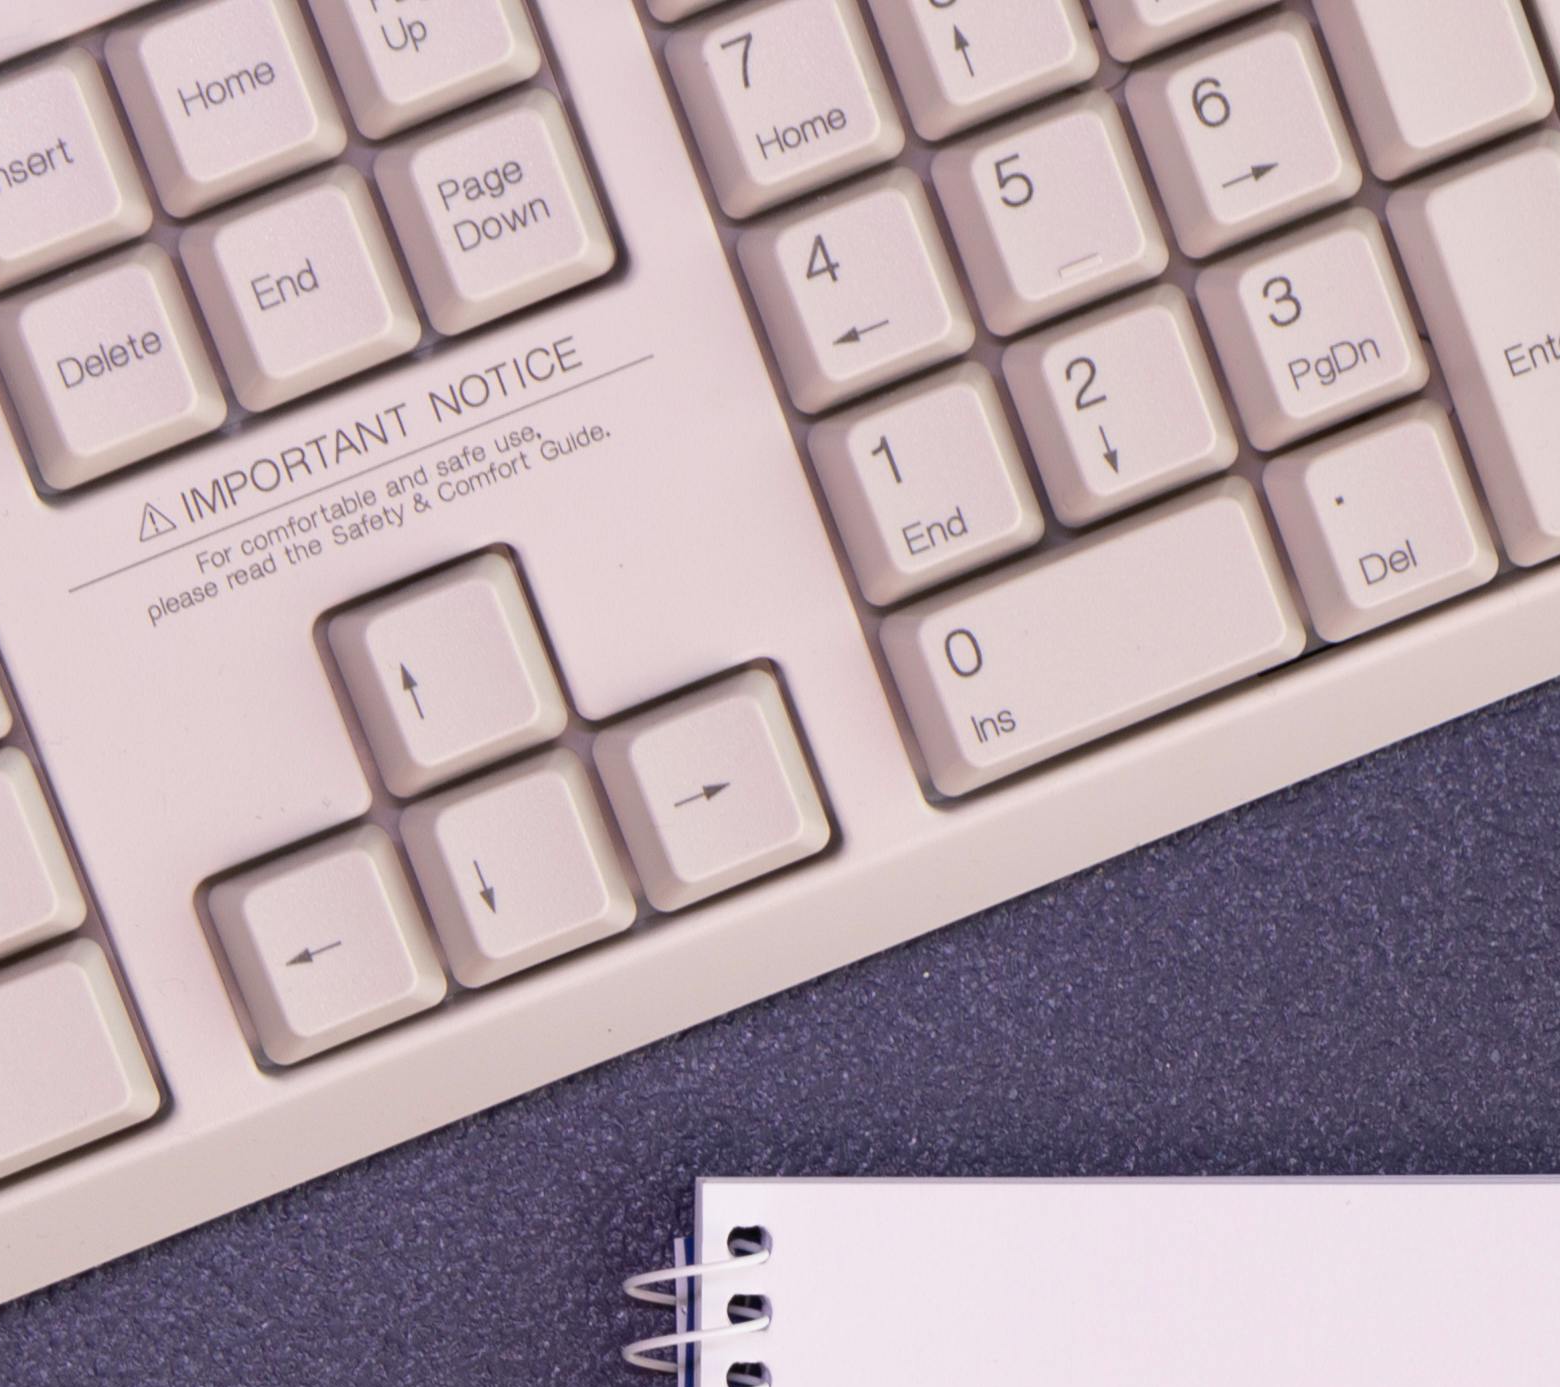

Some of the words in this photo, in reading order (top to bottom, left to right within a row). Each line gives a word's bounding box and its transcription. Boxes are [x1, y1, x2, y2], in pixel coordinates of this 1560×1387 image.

[380, 17, 428, 53] Up
[720, 32, 753, 89] 7
[177, 61, 276, 117] Home
[1191, 77, 1231, 129] 6
[755, 108, 848, 160] Home
[437, 160, 524, 212] Page
[994, 153, 1034, 209] 5
[453, 197, 551, 253] Down
[250, 257, 320, 312] End
[805, 234, 840, 283] 4
[1262, 276, 1302, 328] 3
[56, 331, 163, 389] Delete
[1065, 356, 1107, 411] 2
[1287, 338, 1381, 391] PgDn
[180, 403, 409, 525] IMPORTANT
[428, 336, 582, 422] NOTICE
[871, 435, 903, 484] 1
[147, 583, 220, 627] please
[226, 556, 278, 591] read
[284, 538, 325, 567] the
[332, 505, 406, 547] Safety
[412, 494, 432, 514] &
[438, 454, 532, 503] Comfort
[541, 422, 612, 461] Guide.
[195, 547, 233, 575] For
[240, 487, 378, 556] comfortable
[385, 467, 429, 498] and
[435, 444, 488, 478] safe
[901, 505, 969, 556] End
[1358, 539, 1418, 586] Del
[944, 628, 983, 678] 0
[970, 709, 1017, 744] Ins
